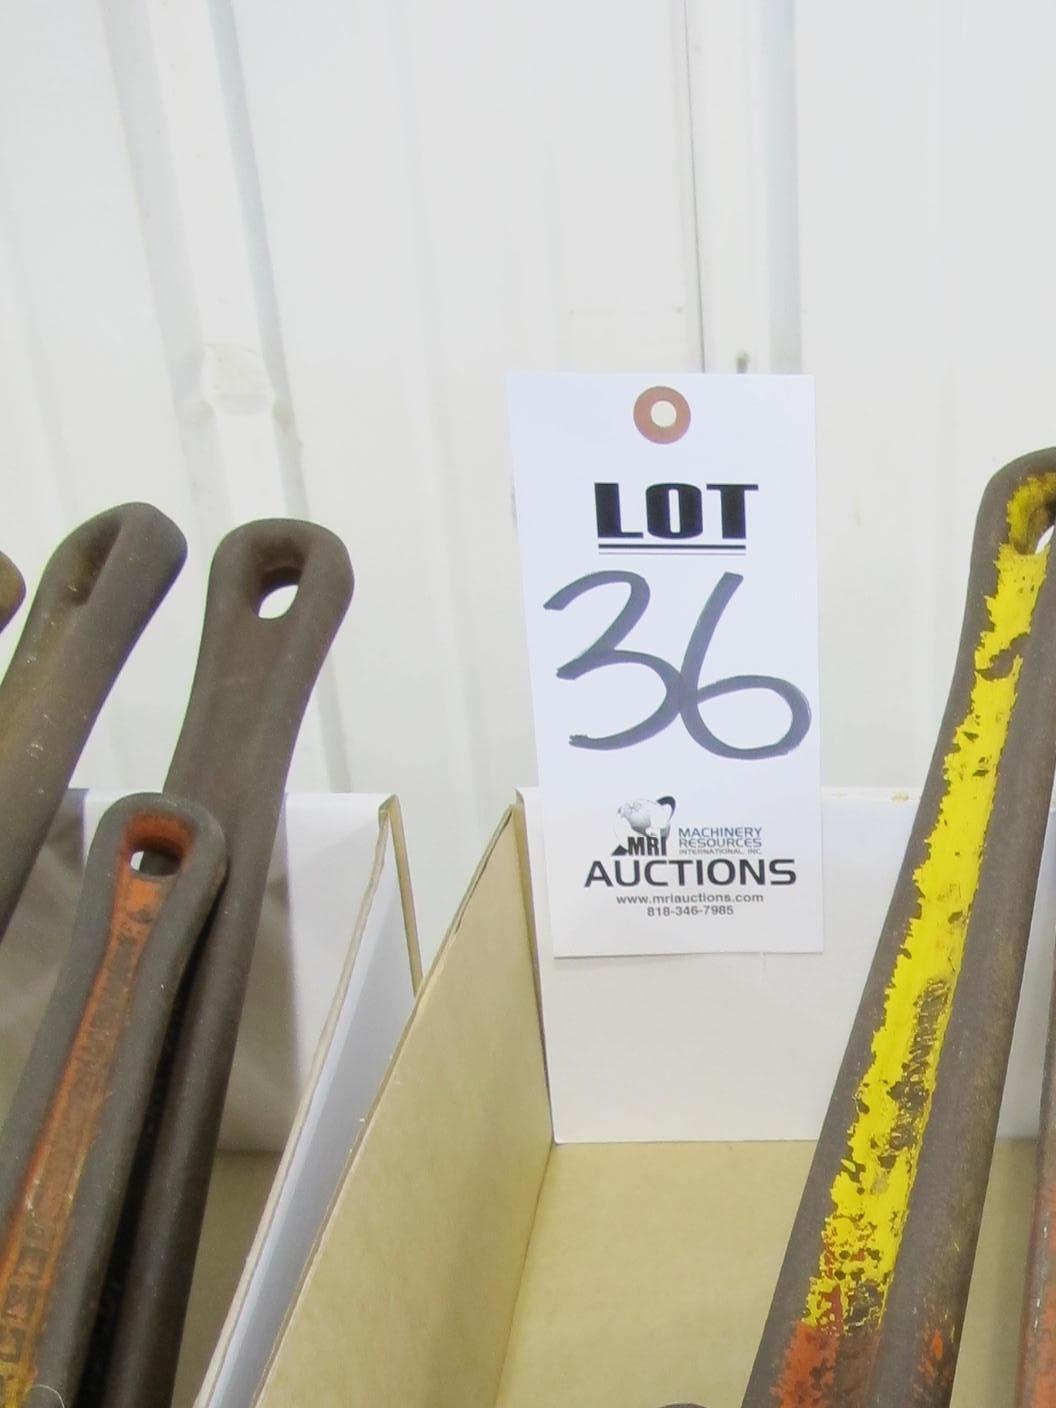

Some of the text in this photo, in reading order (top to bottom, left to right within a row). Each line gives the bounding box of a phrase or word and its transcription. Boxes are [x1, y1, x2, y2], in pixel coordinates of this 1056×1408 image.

[594, 482, 759, 539] LOT
[544, 570, 811, 759] 36
[678, 827, 762, 838] MACHINERY
[627, 836, 667, 856] MRI
[679, 838, 762, 848] RESOURCES
[584, 858, 797, 887] AUCTIONS
[616, 893, 764, 904] www.mriauctions.com
[647, 905, 734, 917] 818-346-7985
